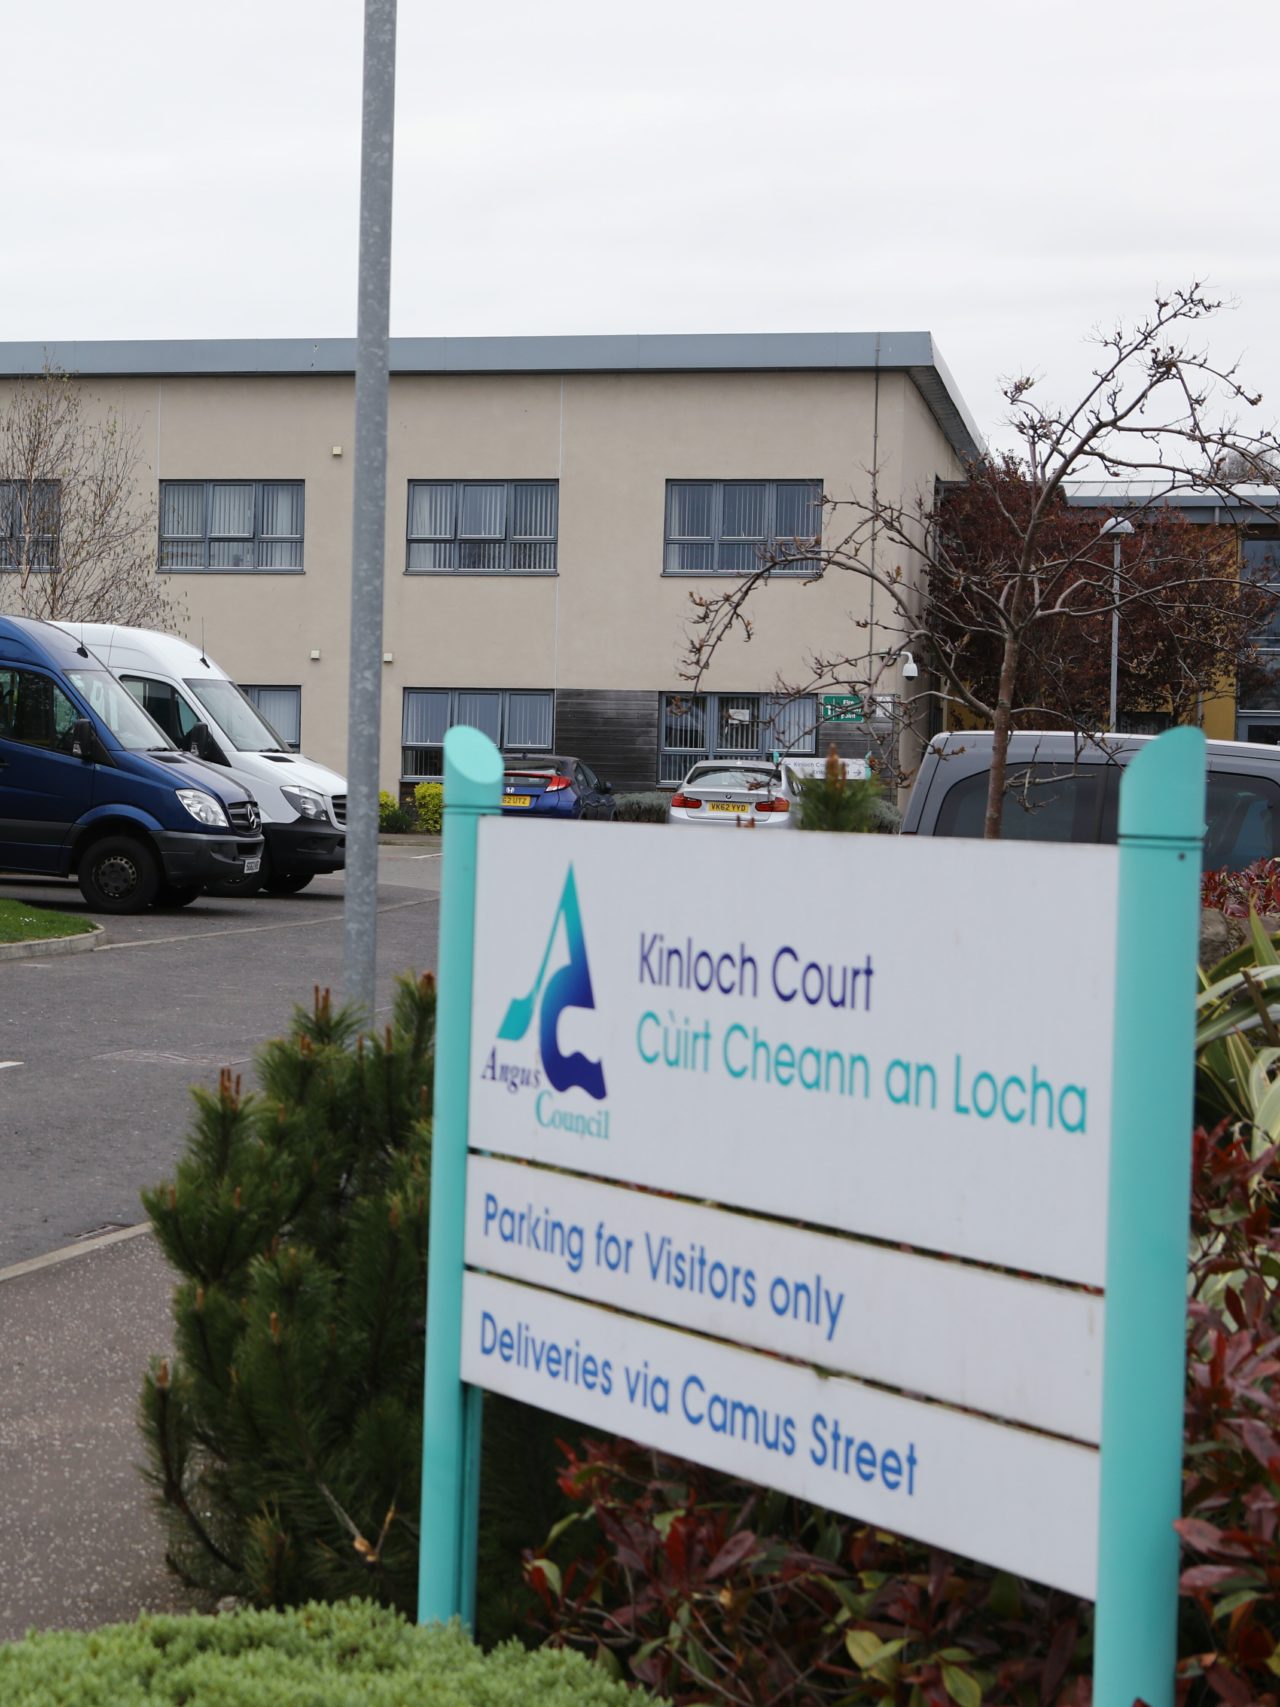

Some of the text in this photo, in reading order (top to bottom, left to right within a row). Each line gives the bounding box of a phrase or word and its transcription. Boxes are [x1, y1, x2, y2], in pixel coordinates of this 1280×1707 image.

[638, 932, 873, 1011] Kinloch Court
[481, 1045, 541, 1094] Angus
[535, 1088, 609, 1140] Council
[637, 1010, 1088, 1134] Cùirt Cheann an Locha
[484, 1193, 844, 1341] Parking for Visitors only
[479, 1311, 918, 1496] Deliveries via Camus Street
